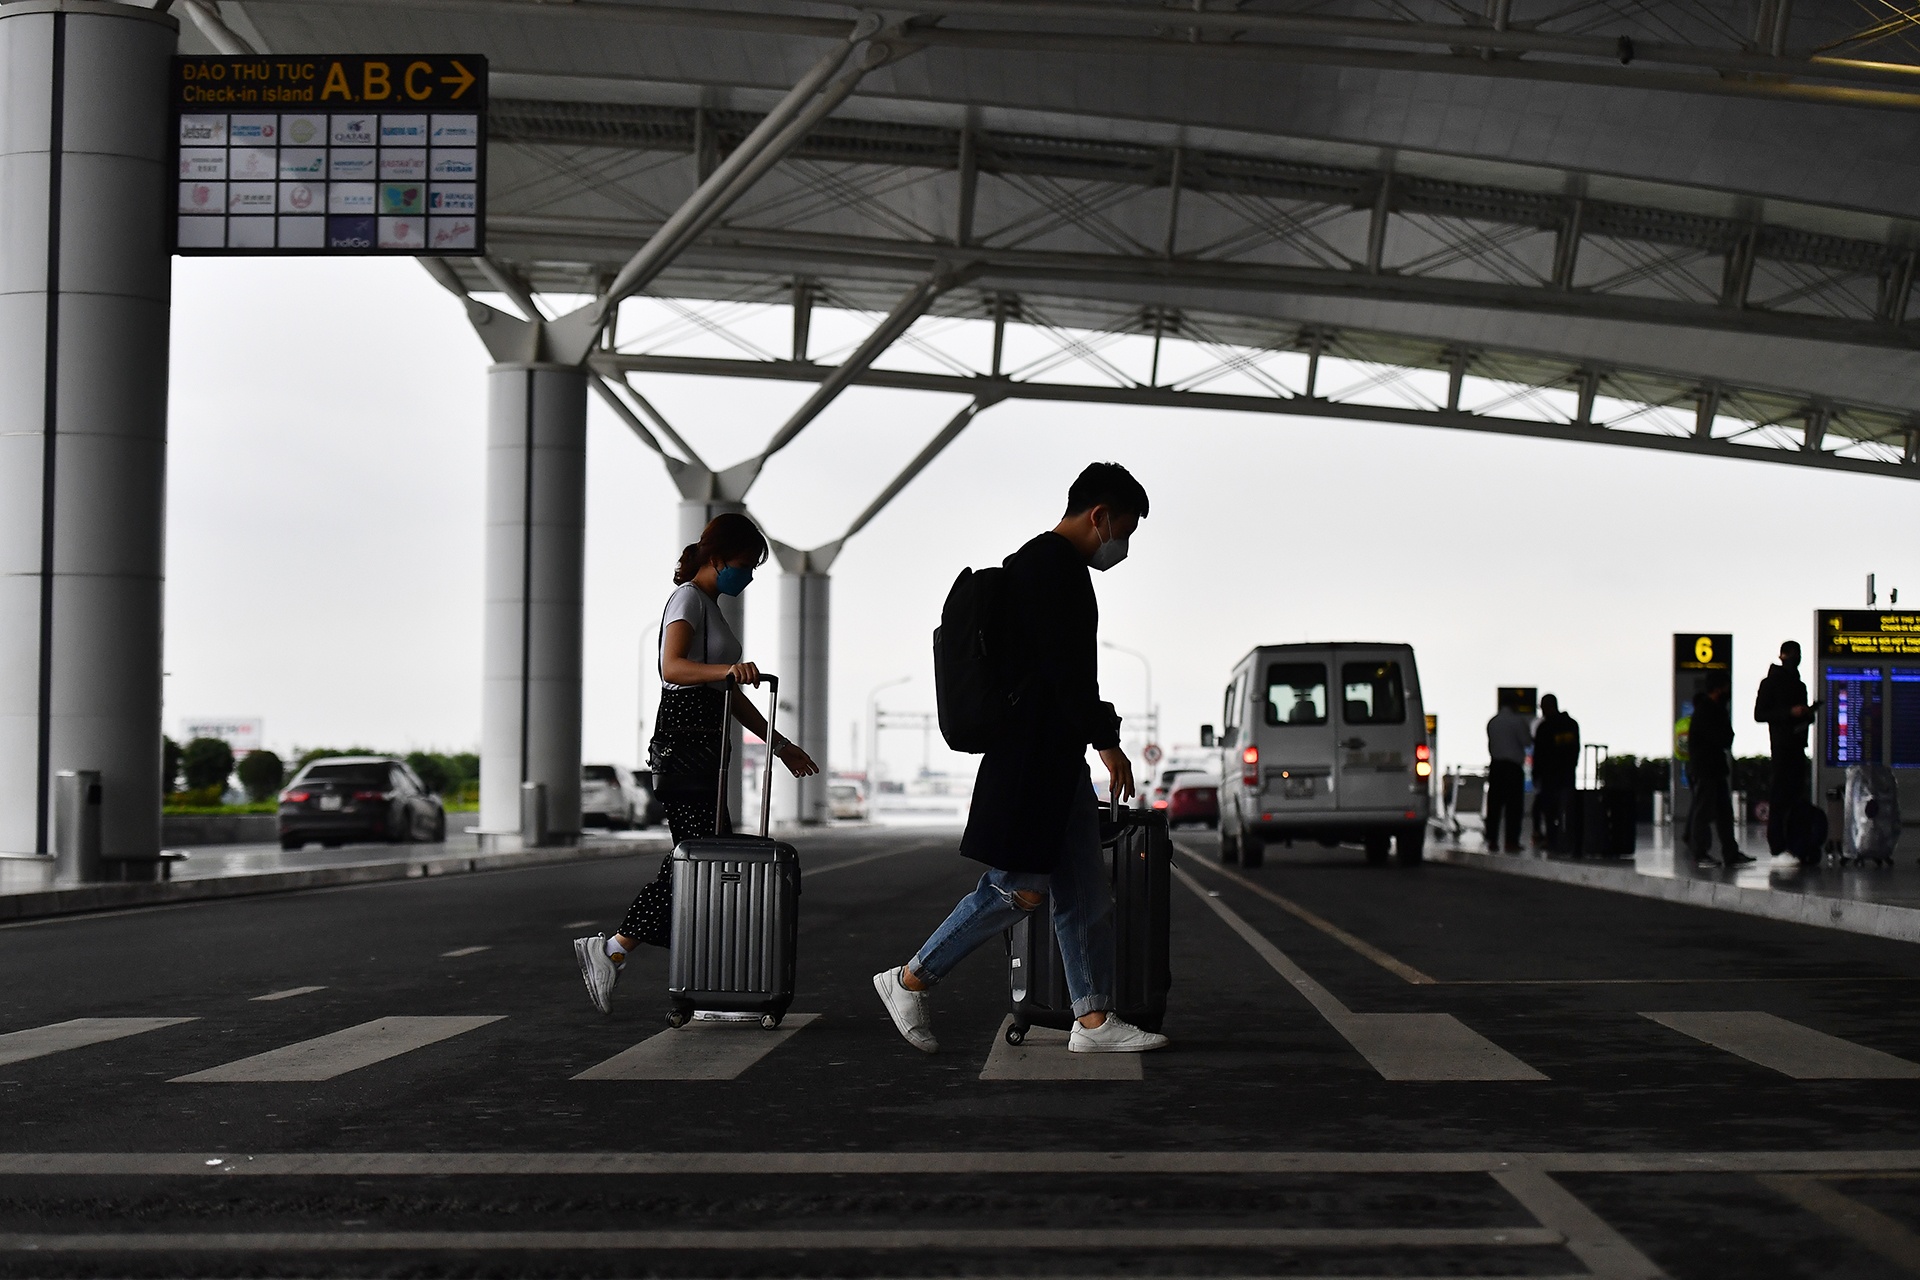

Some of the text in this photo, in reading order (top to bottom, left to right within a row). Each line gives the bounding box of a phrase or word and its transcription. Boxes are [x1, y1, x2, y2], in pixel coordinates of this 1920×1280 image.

[276, 63, 315, 83] TỤC
[183, 85, 314, 102] Check-in island
[331, 237, 370, 248] IndiGo
[1695, 636, 1713, 664] 6
